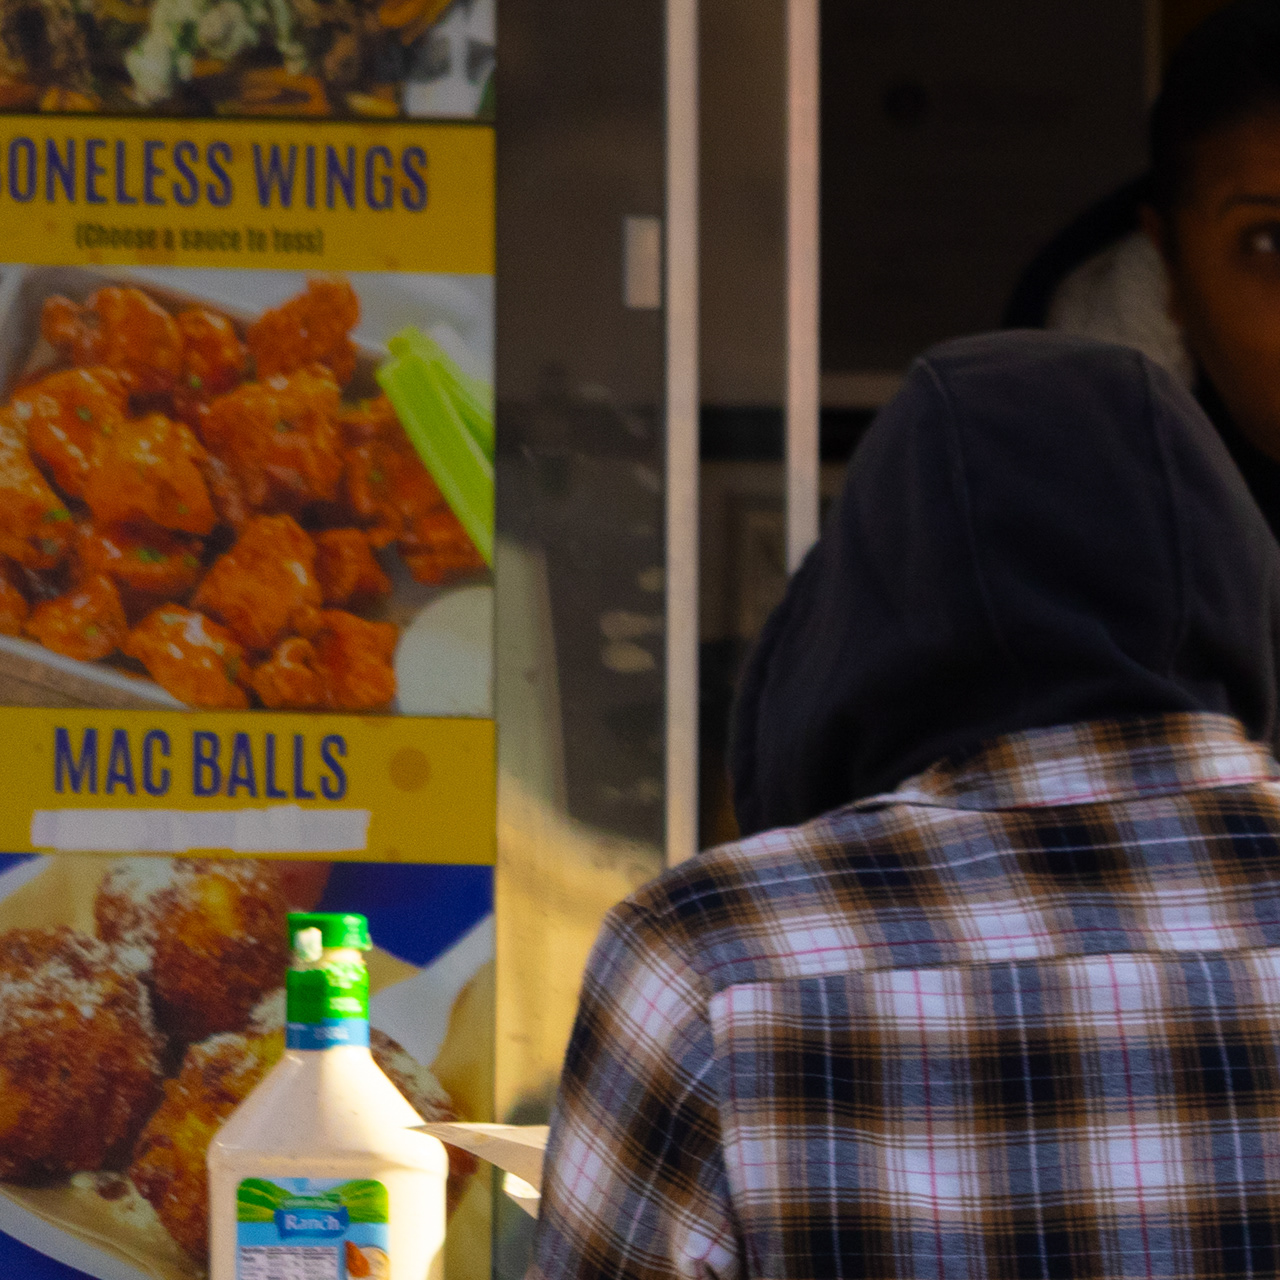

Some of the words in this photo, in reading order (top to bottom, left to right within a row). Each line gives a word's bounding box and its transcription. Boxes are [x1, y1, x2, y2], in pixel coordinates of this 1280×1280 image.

[0, 136, 234, 209] ONELESS
[252, 141, 430, 213] WINGS
[180, 228, 242, 252] sauce
[54, 726, 171, 797] MAC
[191, 730, 349, 802] BALLS
